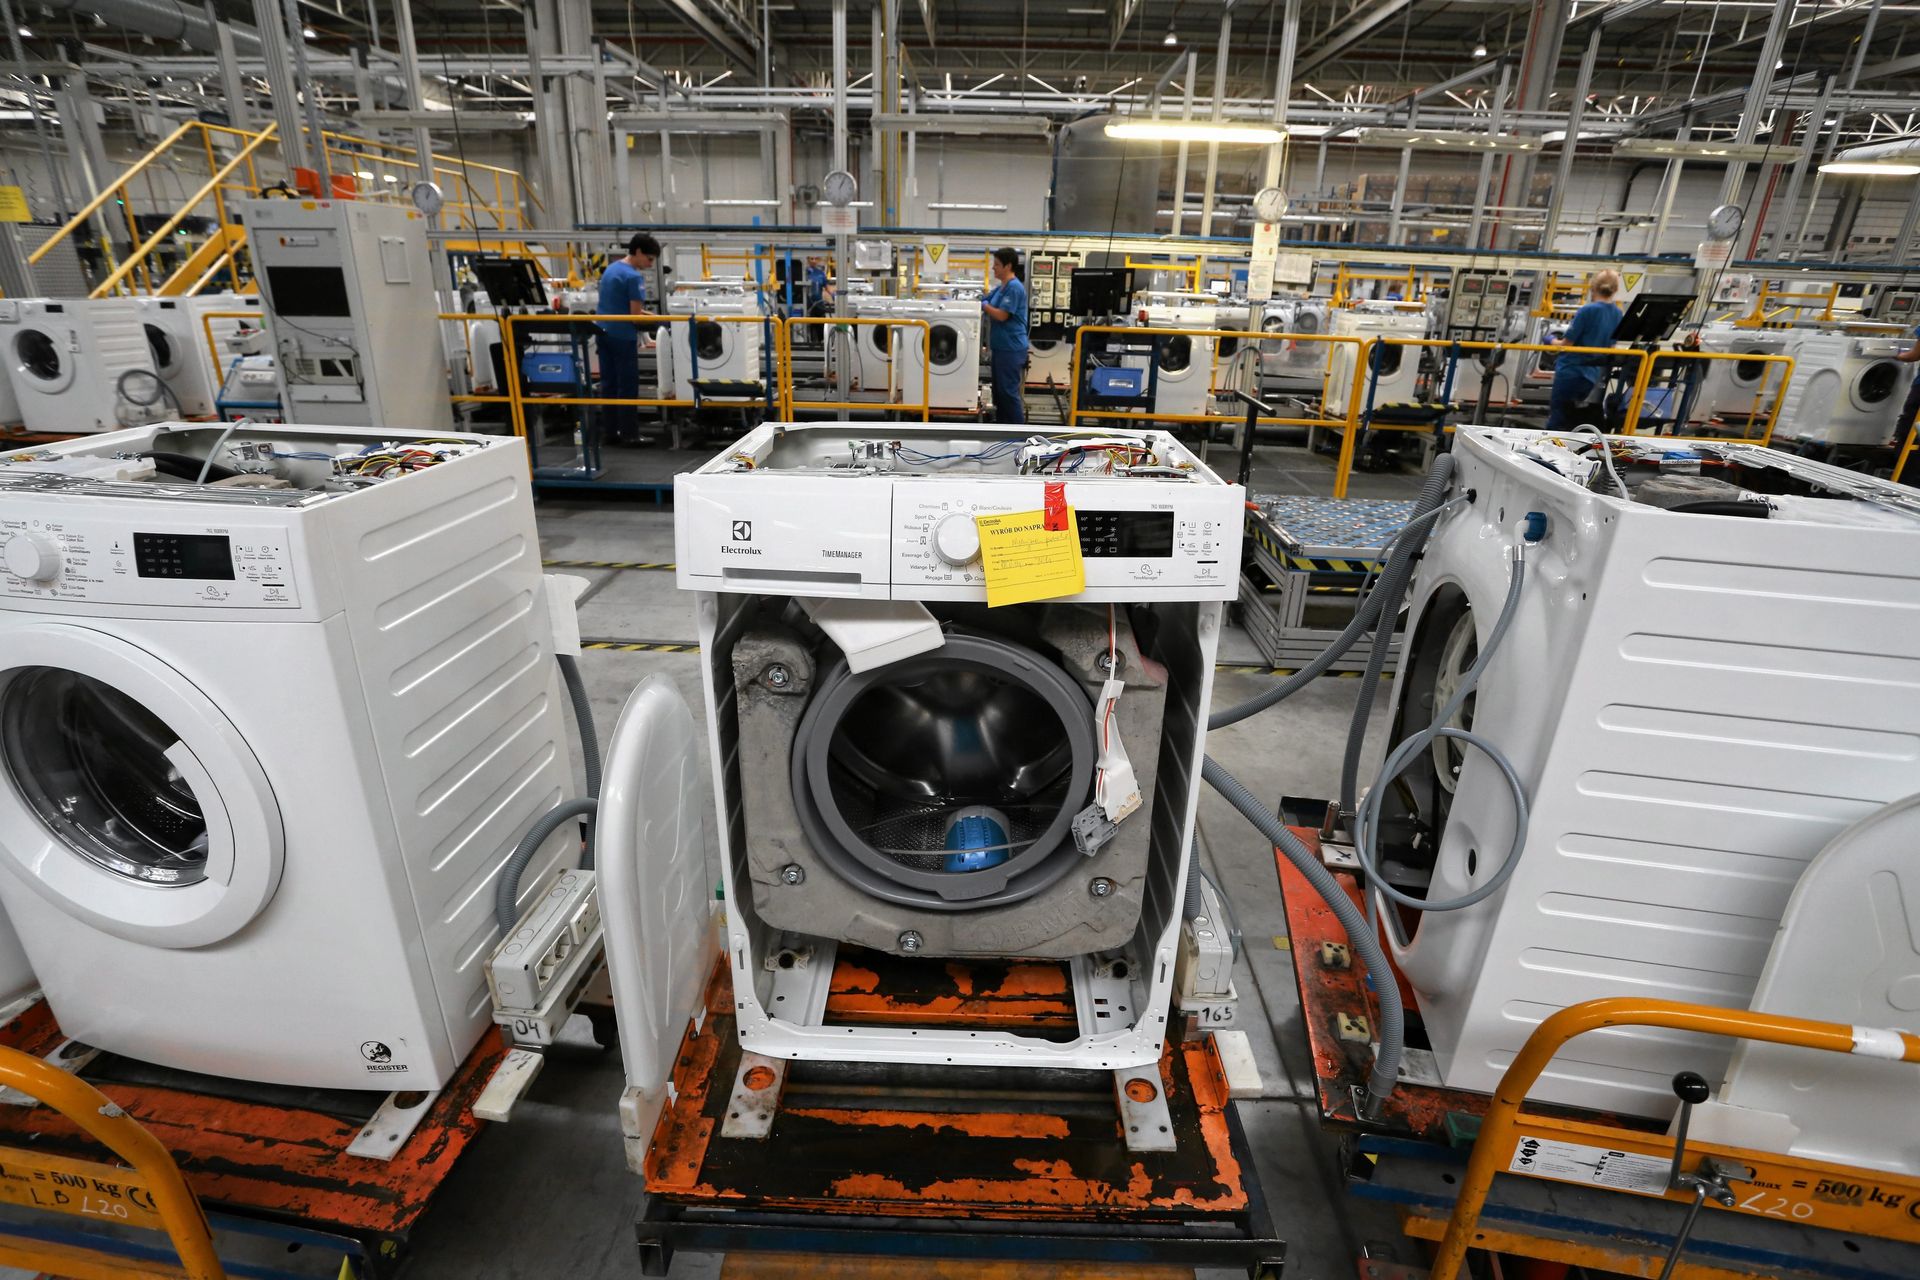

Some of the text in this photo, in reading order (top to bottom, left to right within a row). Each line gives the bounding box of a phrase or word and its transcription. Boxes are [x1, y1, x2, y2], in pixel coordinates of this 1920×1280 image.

[990, 526, 1013, 536] WYRÓB
[1014, 525, 1023, 533] DO
[721, 545, 762, 556] Electrolux
[1202, 1006, 1232, 1022] 165
[515, 1019, 541, 1039] 04
[51, 1171, 87, 1189] 500
[92, 1179, 122, 1199] kg
[1814, 1178, 1862, 1199] 500
[1868, 1187, 1905, 1208] kg
[81, 1196, 128, 1219] L20
